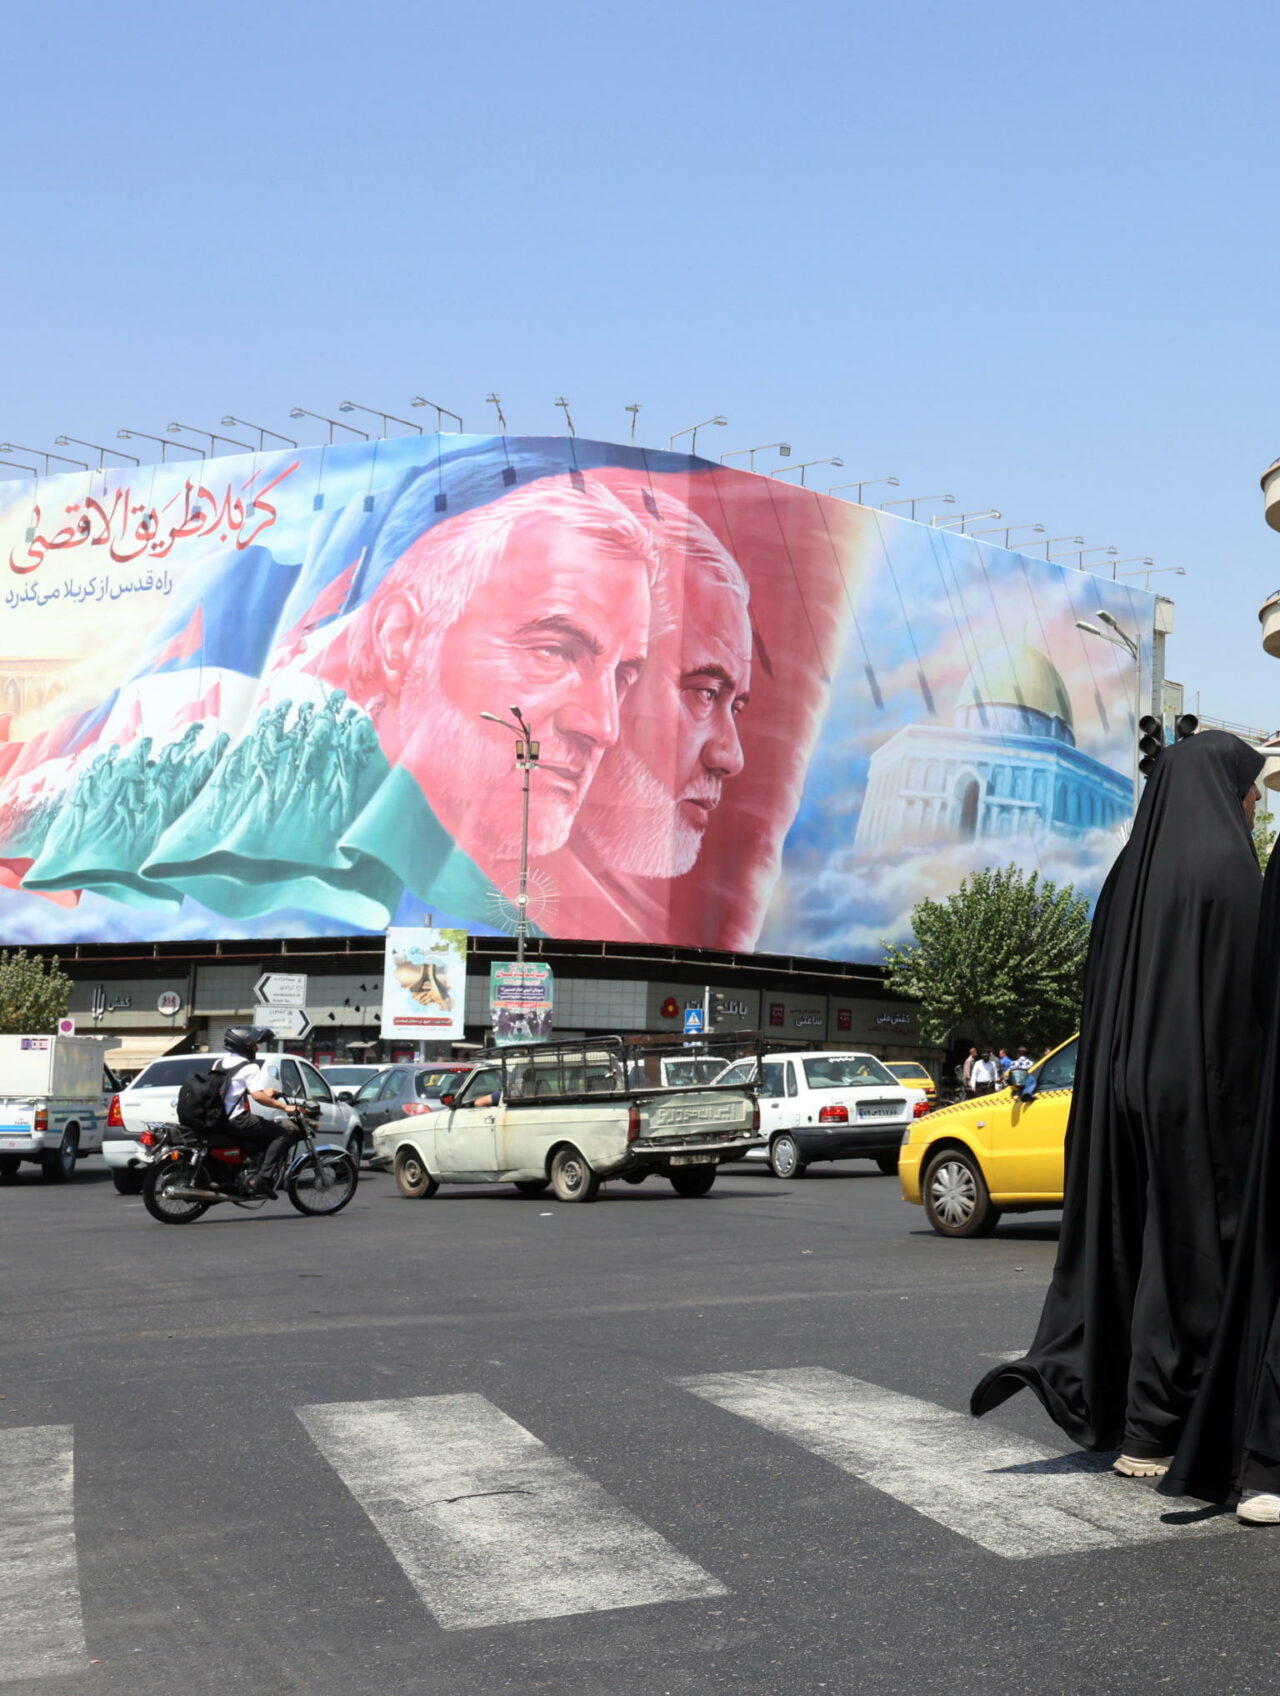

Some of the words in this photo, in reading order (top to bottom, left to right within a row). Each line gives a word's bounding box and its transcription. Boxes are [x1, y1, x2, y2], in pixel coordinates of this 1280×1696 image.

[64, 577, 97, 603] کربلا
[96, 576, 109, 601] از
[110, 570, 153, 600] قدس
[155, 571, 173, 595] راه
